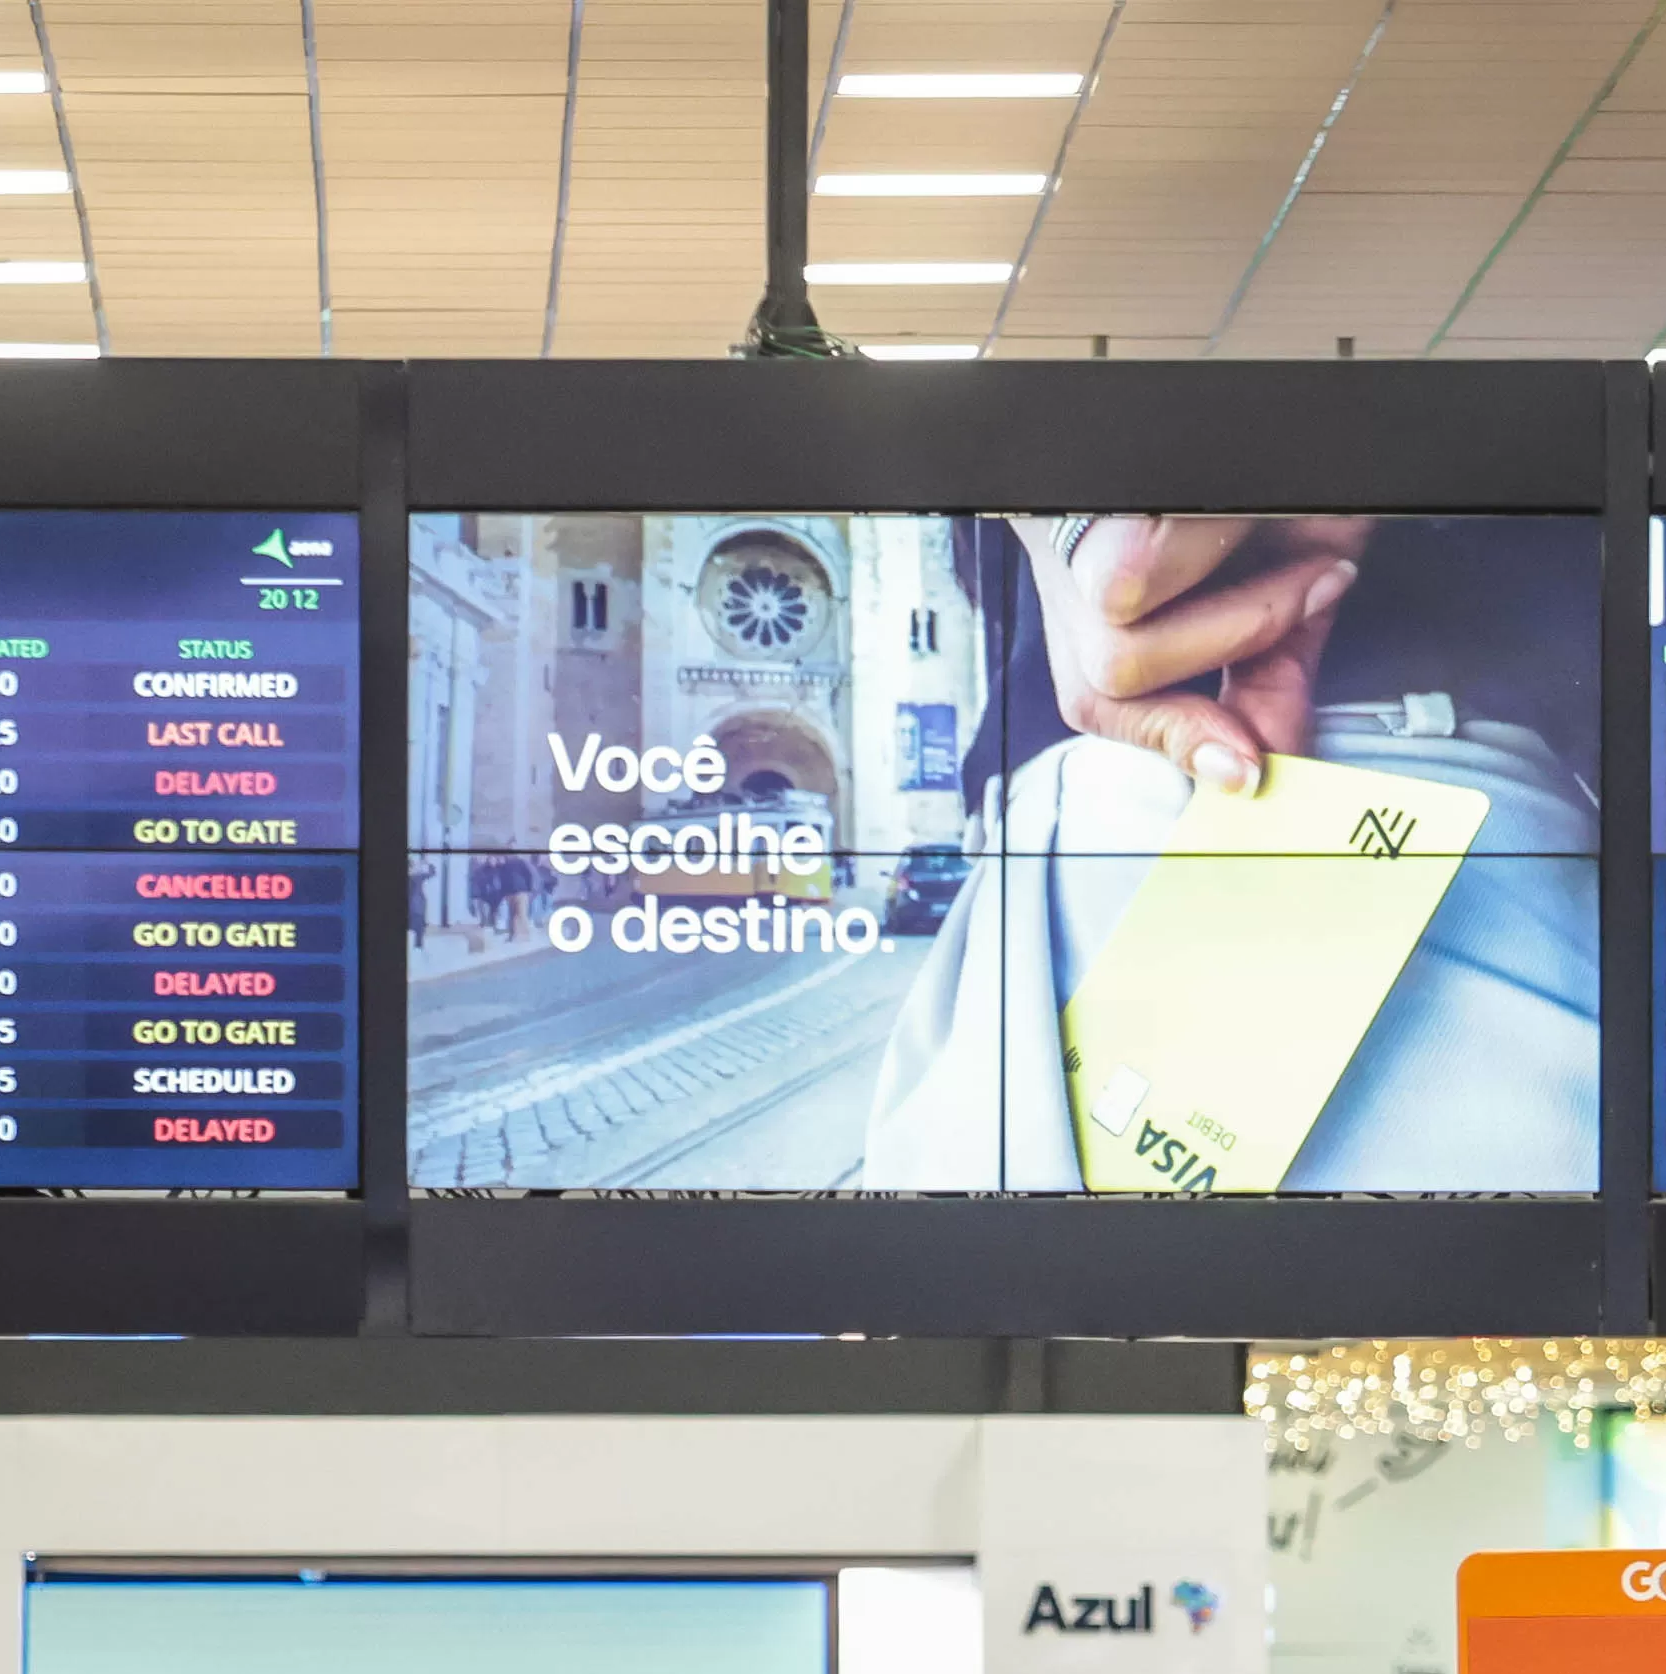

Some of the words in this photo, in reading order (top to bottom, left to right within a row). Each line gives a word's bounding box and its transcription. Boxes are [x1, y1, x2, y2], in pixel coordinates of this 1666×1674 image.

[178, 638, 257, 659] STATUS
[133, 672, 298, 698] CONFIRMED
[148, 722, 213, 746] LAST
[217, 723, 284, 746] CALL
[547, 733, 726, 794] Você
[155, 771, 277, 795] DELAYED
[134, 820, 179, 843] GO
[181, 820, 222, 843] TO
[227, 820, 297, 844] GATE
[548, 812, 824, 876] escolhe
[136, 874, 292, 899] CANCELLED
[133, 923, 178, 946] GO
[181, 922, 221, 946] TO
[226, 923, 295, 947] GATE
[548, 905, 594, 954] o
[611, 894, 896, 954] destino.
[155, 972, 275, 996] DELAYED
[134, 1021, 177, 1043] GO
[181, 1021, 220, 1044] TO
[226, 1021, 295, 1044] GATE
[134, 1068, 295, 1093] SCHEDULED
[155, 1118, 275, 1142] DELAYED
[1135, 1119, 1217, 1192] VISA
[1023, 1581, 1154, 1634] Azul
